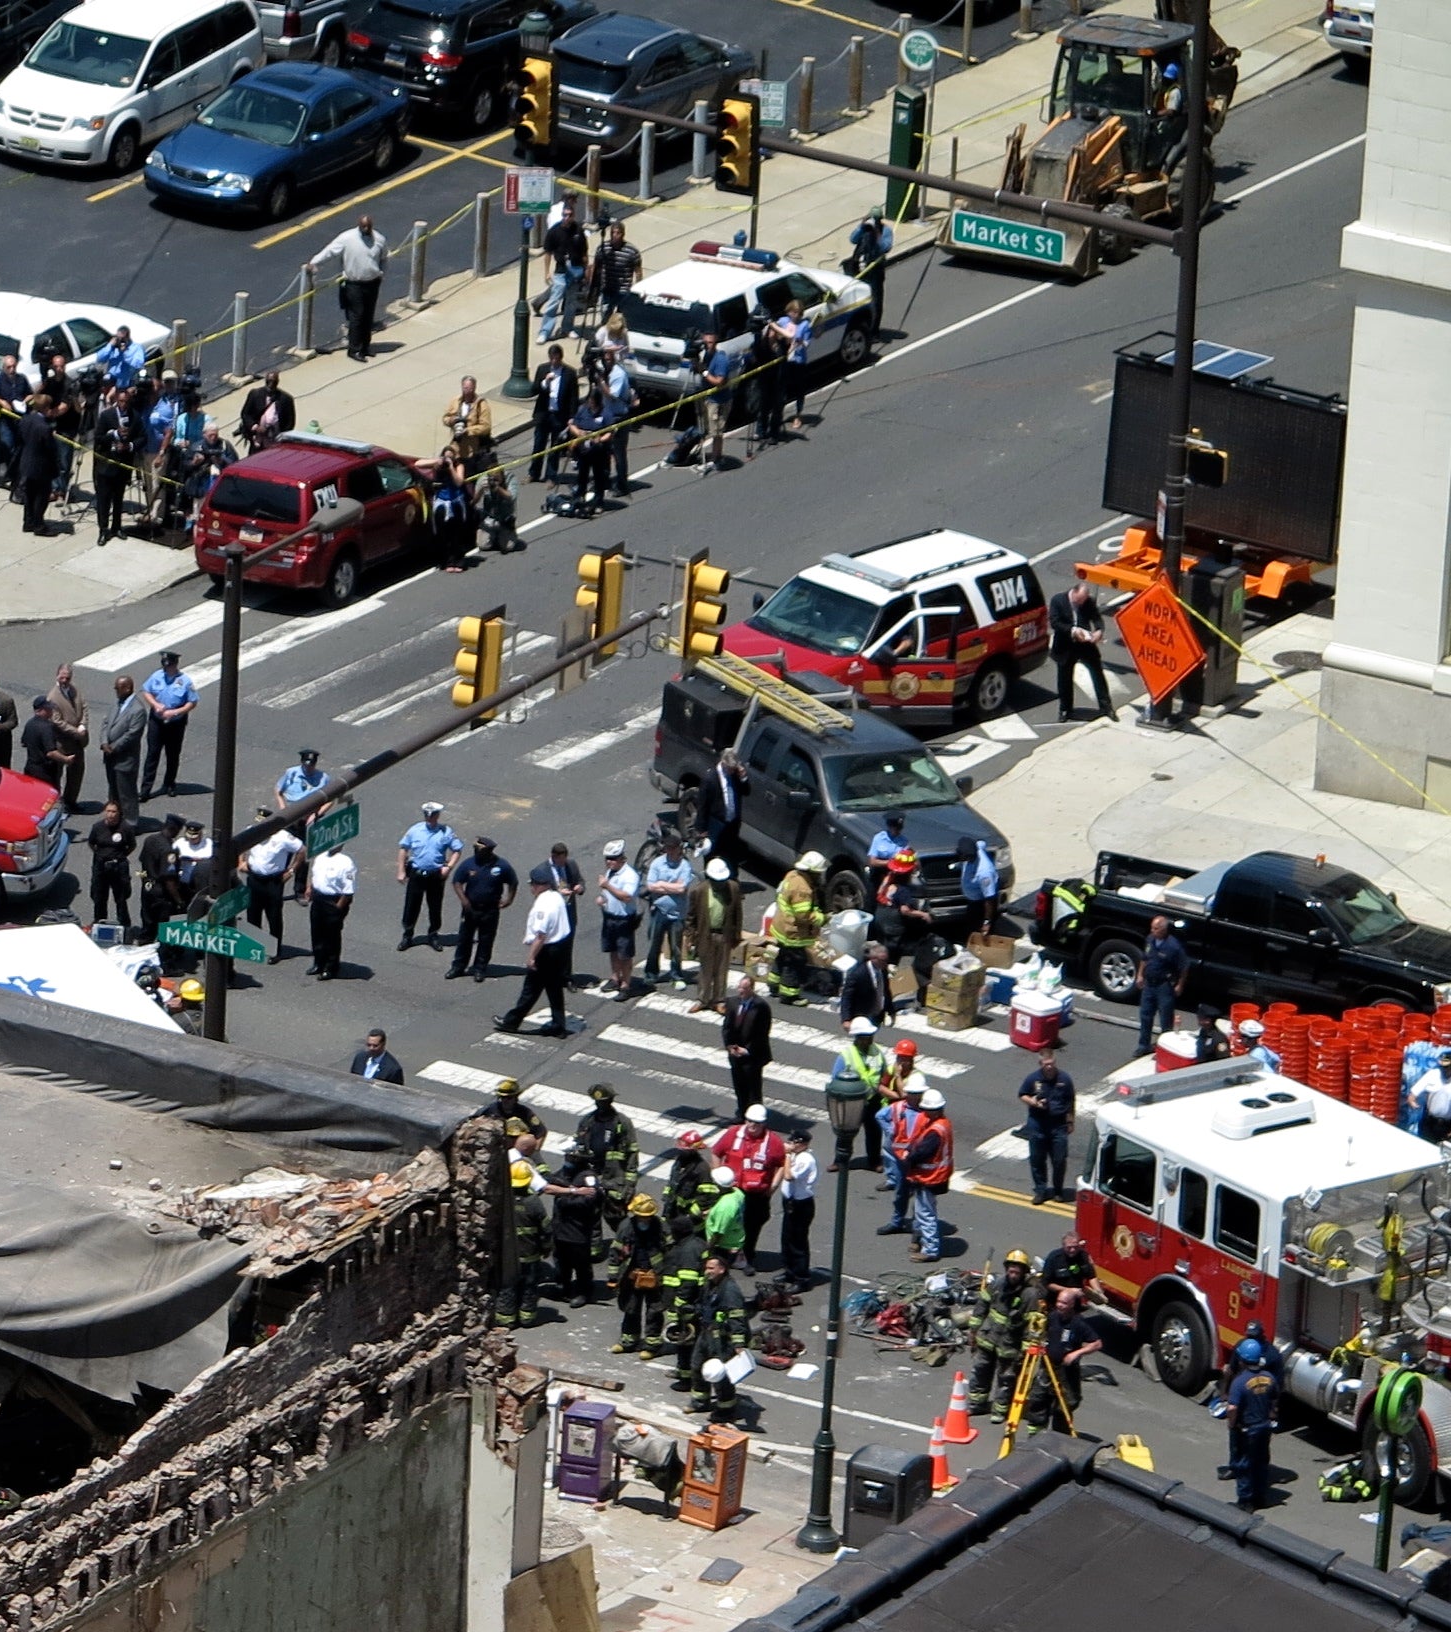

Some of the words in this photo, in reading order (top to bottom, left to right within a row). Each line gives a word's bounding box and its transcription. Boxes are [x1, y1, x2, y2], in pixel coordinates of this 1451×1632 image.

[963, 219, 1029, 250] Market
[1035, 234, 1054, 256] St
[644, 295, 692, 311] POLICE
[990, 575, 1028, 612] BN4
[1144, 600, 1178, 626] WORK
[1142, 623, 1176, 649] AREA
[1138, 644, 1177, 672] AHEAD
[313, 826, 338, 849] 22nd
[342, 815, 354, 833] St
[166, 927, 237, 956] MARKET
[251, 948, 263, 961] ST
[1228, 1291, 1240, 1319] 9
